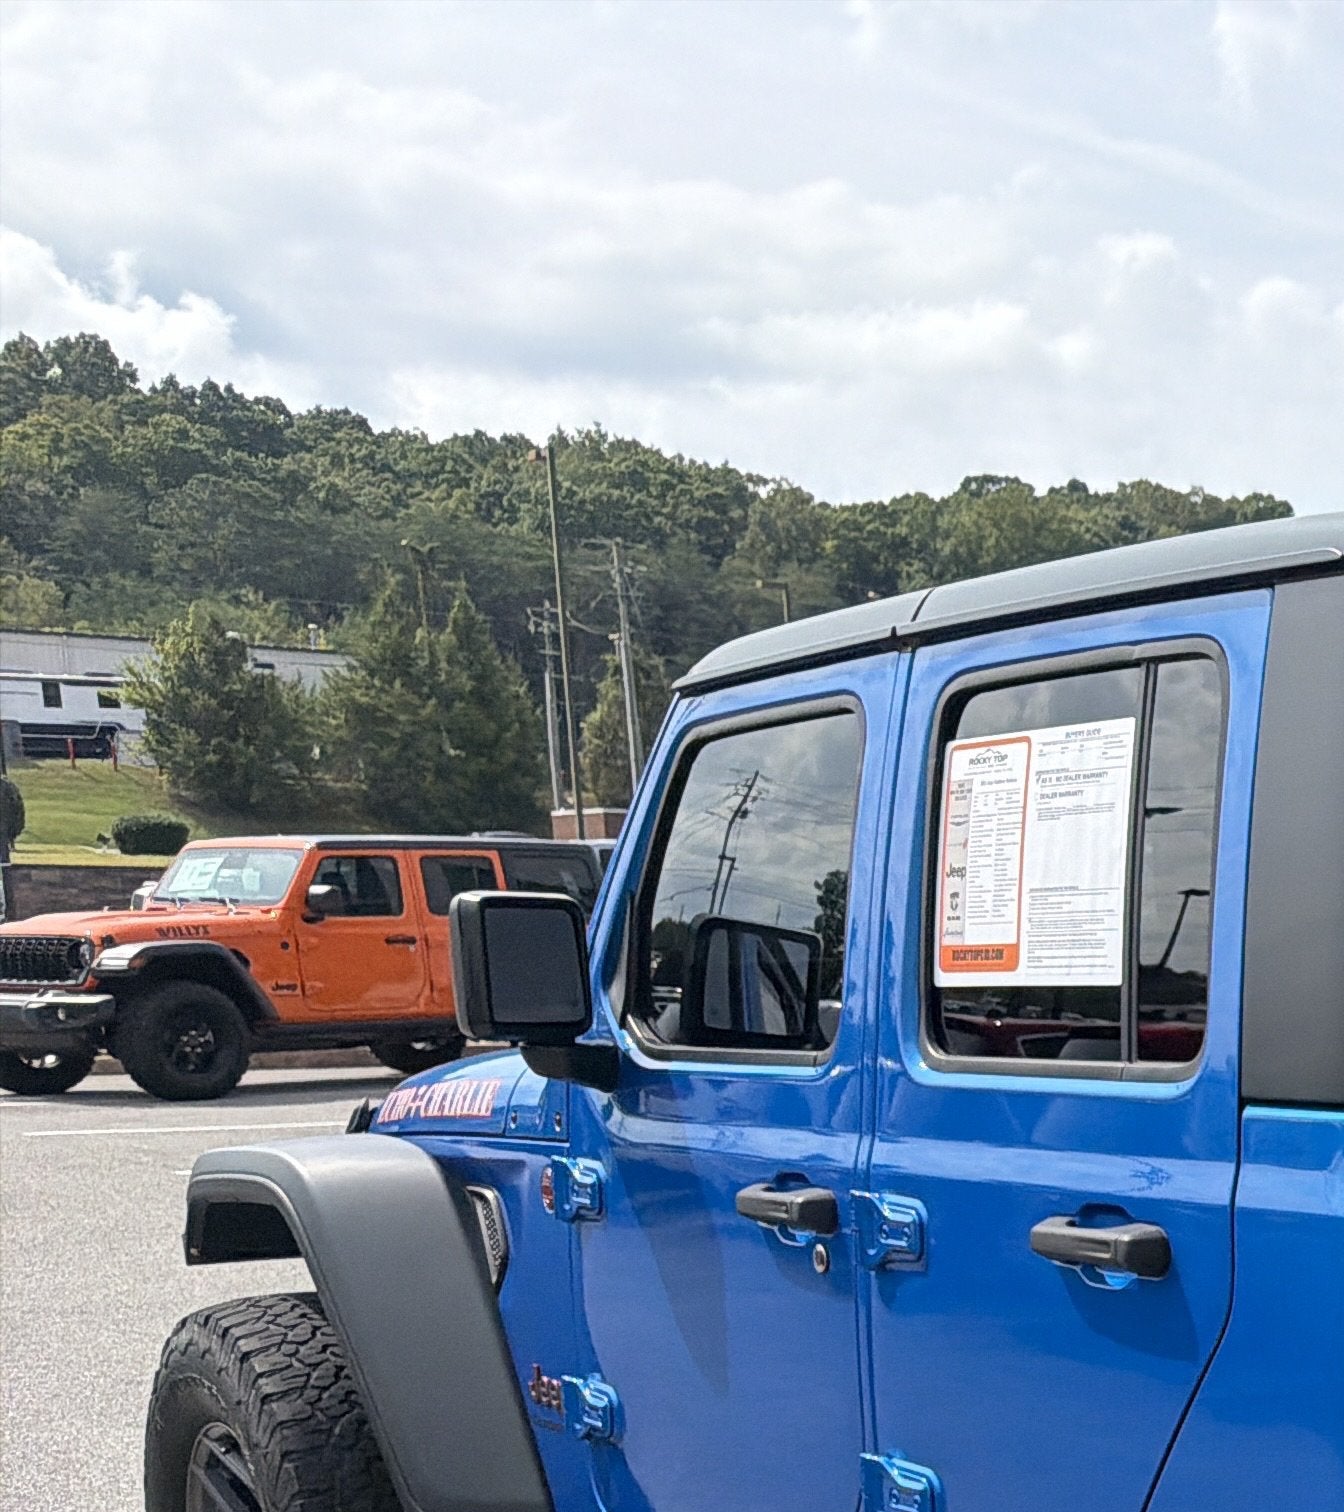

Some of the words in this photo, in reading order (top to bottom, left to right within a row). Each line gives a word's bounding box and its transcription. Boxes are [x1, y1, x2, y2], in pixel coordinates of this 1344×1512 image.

[969, 756, 992, 766] ROCKY
[993, 754, 1008, 763] TOP
[946, 861, 966, 880] Jeep
